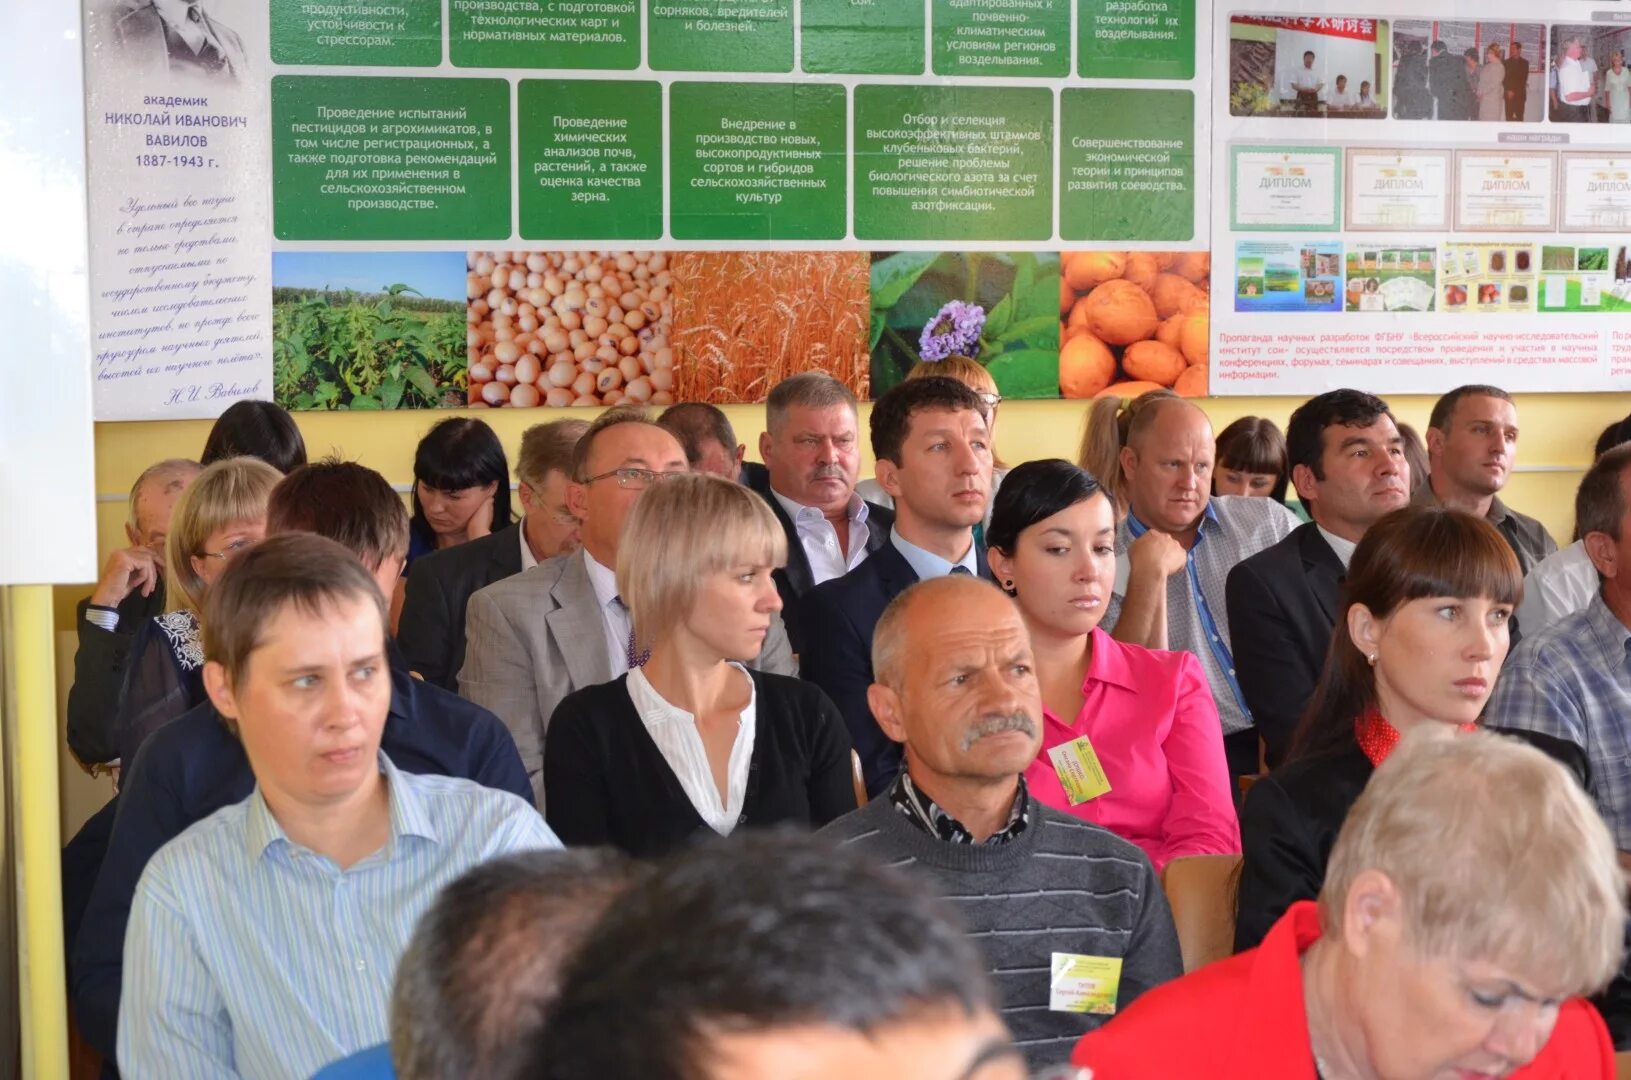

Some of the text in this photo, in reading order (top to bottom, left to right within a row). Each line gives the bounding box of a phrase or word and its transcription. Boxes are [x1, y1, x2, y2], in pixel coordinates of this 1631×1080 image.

[302, 4, 409, 18] продуктивности,
[455, 0, 635, 15] производства, с подготовкой
[654, 6, 788, 20] сорняков, вредителей
[1106, 2, 1168, 13] разработка
[471, 15, 620, 29] технологических карт и
[972, 12, 1030, 23] почвенно-
[1095, 14, 1179, 27] технологий их
[307, 18, 406, 31] устойчивости к
[697, 20, 757, 32] болезней.
[463, 30, 627, 45] нормативных материалов.
[957, 26, 1046, 37] климатическим
[1095, 29, 1177, 41] возделывания.
[317, 35, 396, 48] стрессорам.
[946, 41, 1056, 53] условиям регионов
[959, 55, 1043, 67] возделывания.
[143, 95, 208, 107] академик
[318, 106, 467, 120] Проведение испытаний
[105, 111, 247, 128] НИКОЛАЙ ИВАНОВИЧ
[553, 116, 628, 130] Проведение
[721, 118, 797, 132] Внедрение в
[903, 114, 1006, 127] Отбор и селекция
[292, 123, 492, 137] пестицидов и агрохимикатов, в
[866, 130, 1041, 142] высокоэффективных штаммов
[146, 134, 208, 147] ВАВИЛОВ
[554, 133, 627, 143] химических
[696, 134, 821, 146] производство новых,
[1072, 136, 1183, 150] Совершенствование
[294, 139, 490, 152] том числе регистрационных, а
[884, 142, 1024, 156] клубеньковых бактерий,
[288, 153, 496, 166] также подготовка рекомендаций
[544, 148, 636, 160] анализов почв,
[696, 149, 822, 160] высокопродуктивных
[1086, 151, 1170, 162] экономической
[136, 155, 219, 168] 1887-1943 г.
[534, 160, 648, 174] растений, а также
[898, 157, 1010, 169] решение проблемы
[704, 162, 814, 175] сортов и гибридов
[1072, 167, 1184, 178] теории и принципов
[326, 169, 460, 181] для их применения в
[869, 171, 1038, 183] биологического азота за счет
[320, 182, 466, 194] сельскохозяйственном
[541, 177, 641, 188] оценка качества
[691, 176, 826, 188] сельскохозяйственных
[1067, 181, 1186, 192] развития соеводства.
[1258, 177, 1312, 190] ДИПЛОМ
[1373, 179, 1424, 191] ДИПЛОМ
[1482, 180, 1530, 191] ДИПЛОМ
[872, 185, 1035, 197] повышения симбиотической
[572, 192, 610, 204] зерна.
[736, 193, 782, 204] культур
[348, 199, 438, 211] производстве.
[912, 200, 996, 212] азотфиксации.
